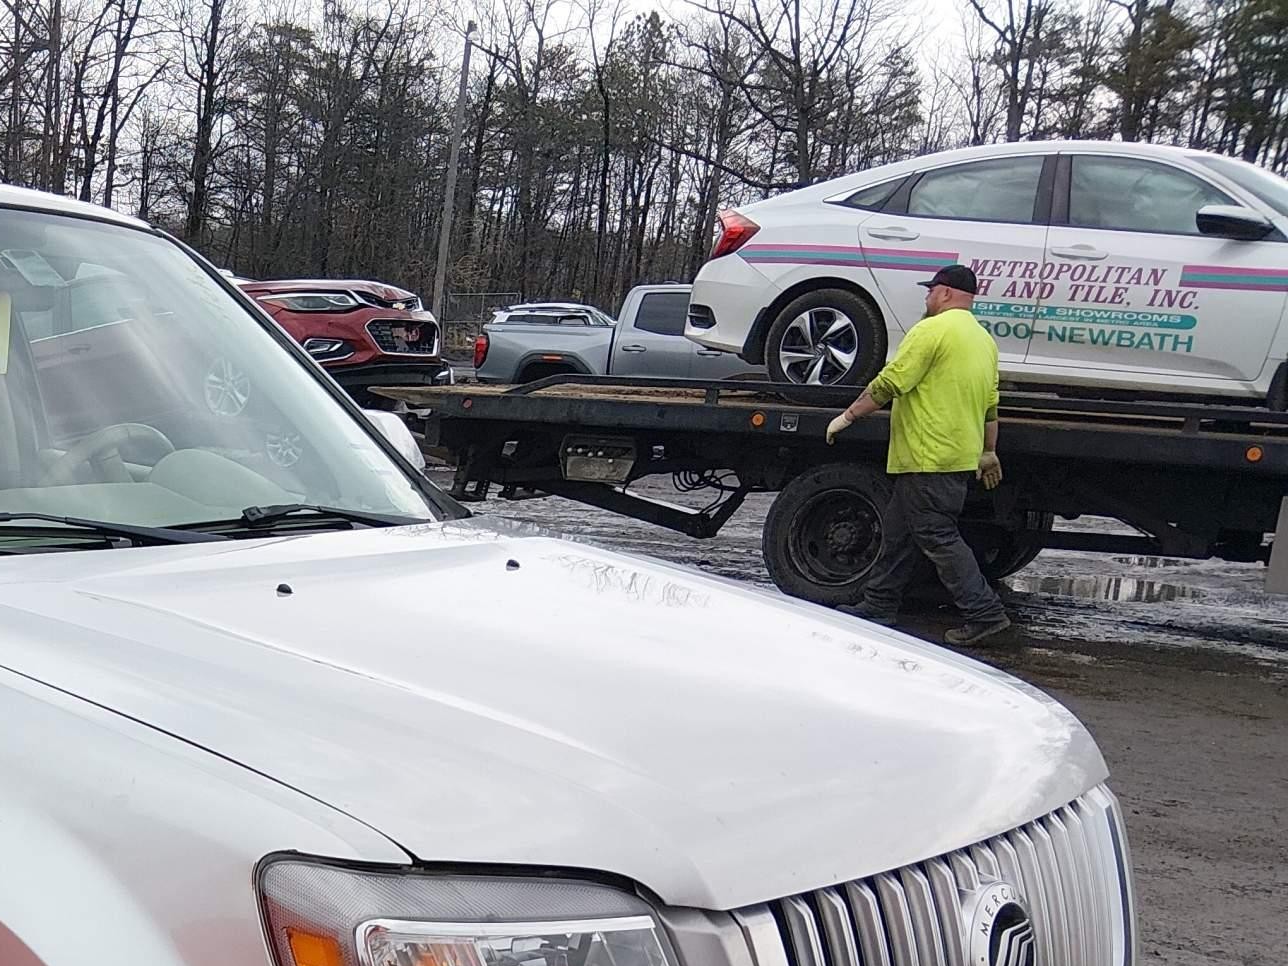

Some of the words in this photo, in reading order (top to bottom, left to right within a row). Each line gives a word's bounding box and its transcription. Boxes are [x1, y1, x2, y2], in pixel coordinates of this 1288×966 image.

[971, 258, 1168, 286] METROPOLITAN
[1002, 280, 1055, 300] AND
[1068, 284, 1131, 307] TILE,
[1146, 288, 1200, 309] INC.
[972, 302, 1003, 310] ISIT
[1010, 304, 1048, 314] OUR
[1055, 307, 1182, 323] SHOWROOMS
